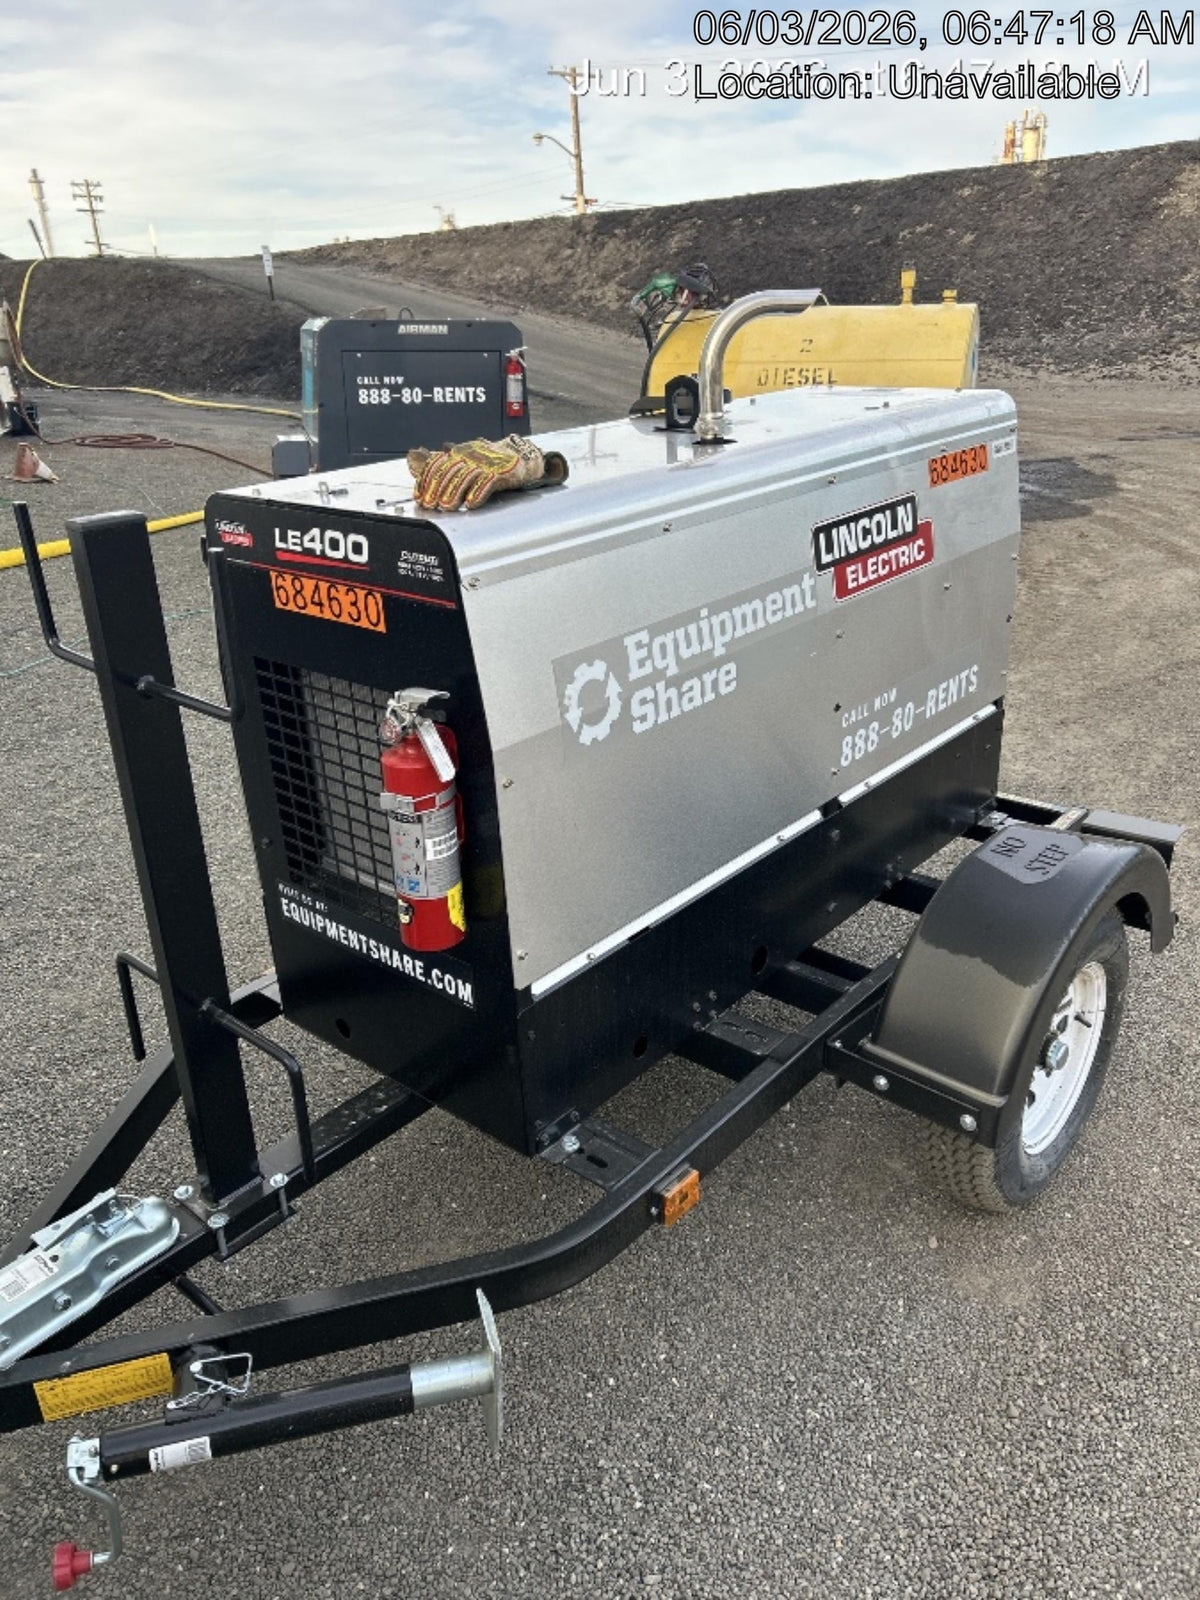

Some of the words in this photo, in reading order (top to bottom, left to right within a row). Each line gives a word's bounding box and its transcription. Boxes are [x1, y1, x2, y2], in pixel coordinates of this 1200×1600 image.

[398, 324, 448, 335] AIRMAN
[357, 376, 381, 385] CALL
[383, 376, 404, 385] NOW
[358, 386, 487, 405] 888-80-RENTS
[756, 366, 839, 387] DIESEL
[929, 444, 988, 485] 684630
[274, 527, 369, 564] LE400
[818, 502, 914, 565] LINCOLN
[845, 538, 926, 590] ELECTRIC
[274, 571, 382, 627] 684630
[623, 572, 817, 682] Equipment
[629, 660, 737, 735] Share
[840, 664, 980, 768] 888-80-RENTS
[842, 705, 869, 728] CALL
[873, 687, 898, 712] NOW
[990, 836, 1027, 859] NO
[1023, 843, 1070, 876] STEP
[280, 896, 475, 1005] EQUIPMENTSHARE.COM
